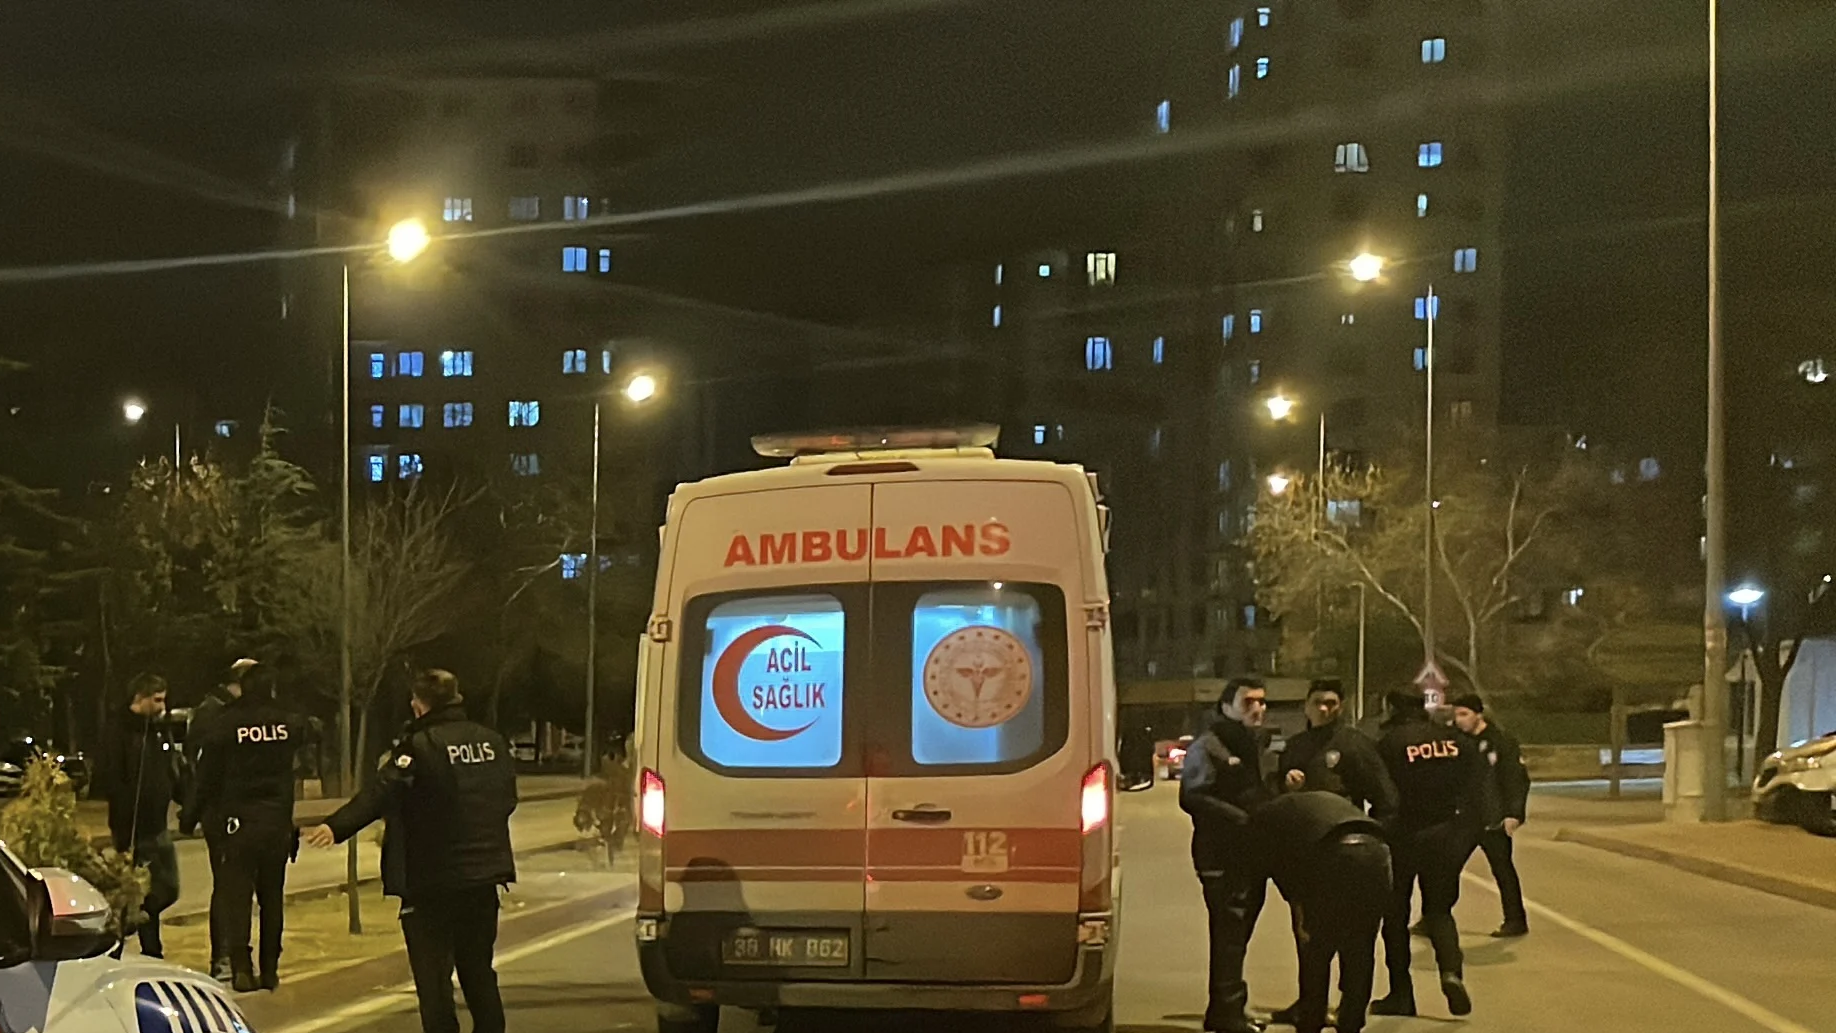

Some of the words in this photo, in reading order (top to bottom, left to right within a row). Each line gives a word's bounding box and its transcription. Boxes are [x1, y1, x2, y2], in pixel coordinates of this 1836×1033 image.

[724, 522, 1011, 568] AMBULANS
[766, 641, 812, 672] ACİL
[752, 675, 826, 710] SAĞLIK
[964, 831, 1007, 856] 112
